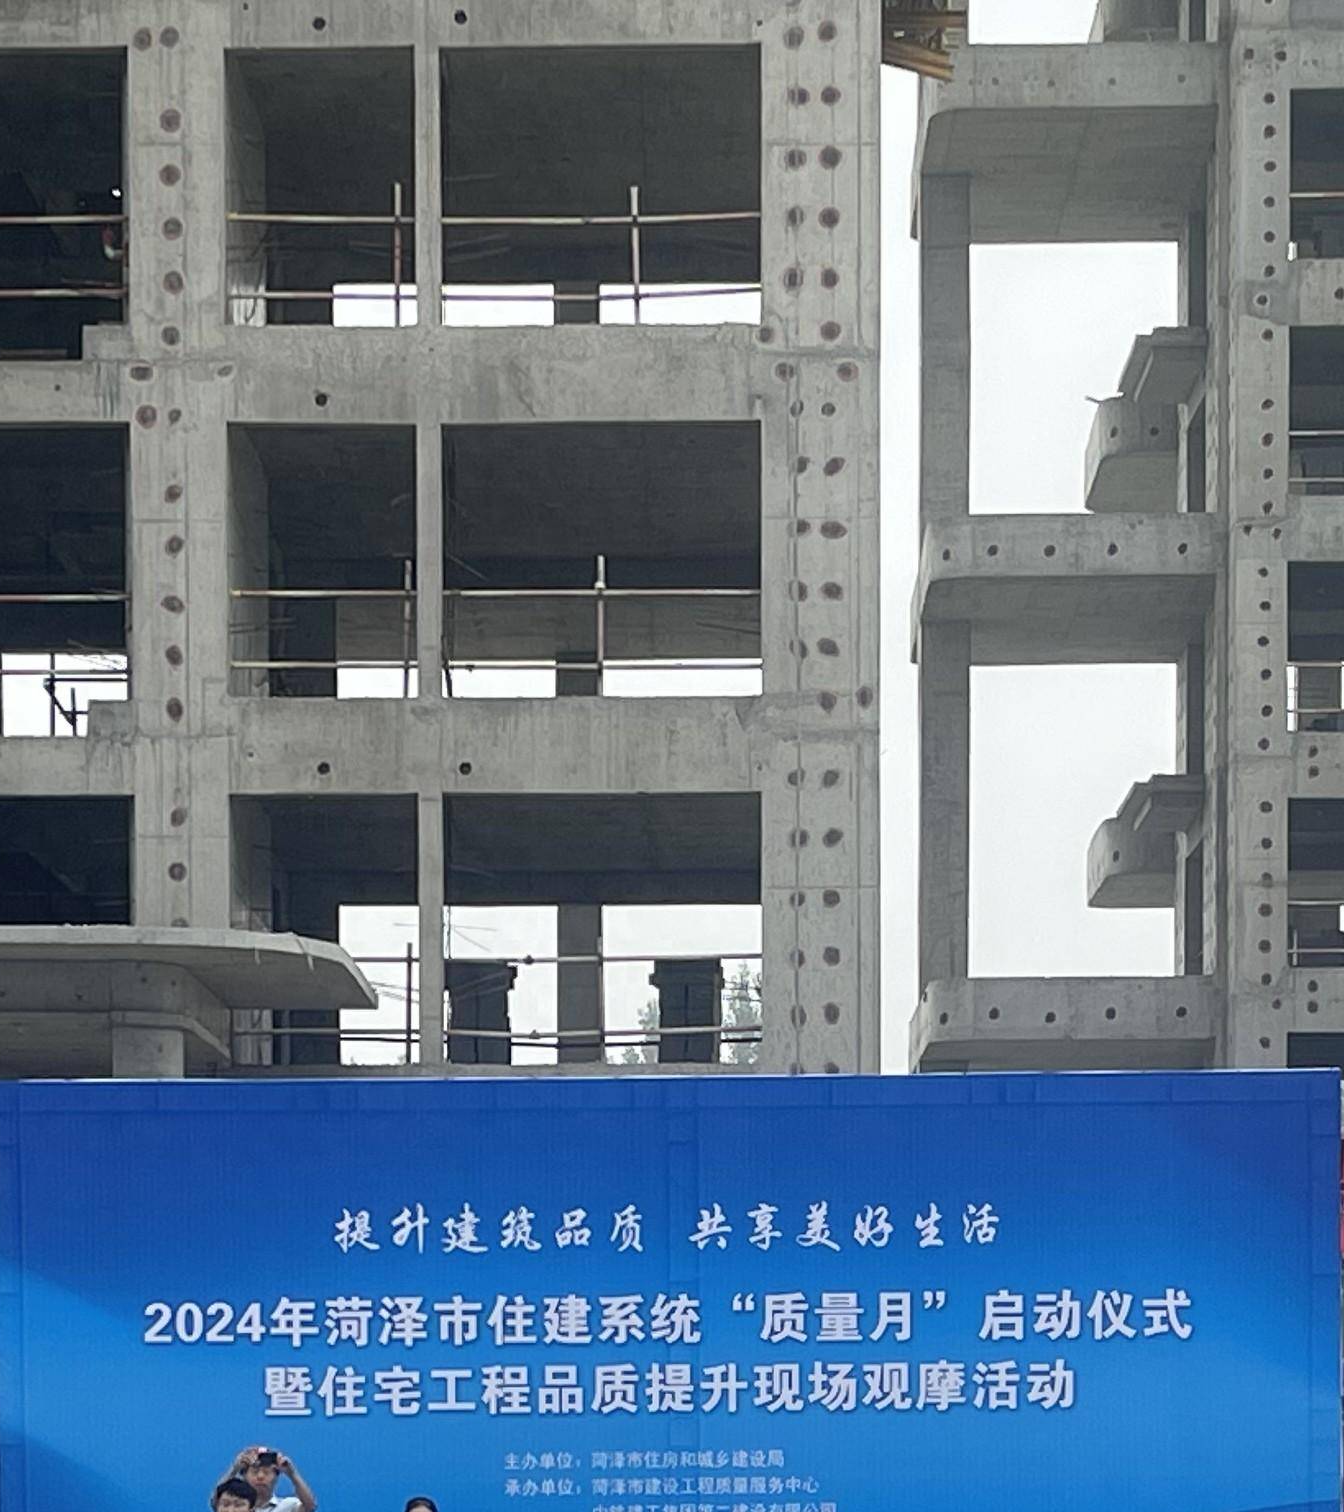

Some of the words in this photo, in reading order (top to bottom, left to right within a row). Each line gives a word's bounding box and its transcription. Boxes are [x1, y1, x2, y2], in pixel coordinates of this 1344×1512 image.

[334, 1201, 646, 1255] 提升建筑品质
[688, 1201, 1002, 1252] 共享美好生活
[264, 1360, 1076, 1418] 暨住宅工程品质提升现场观摩活动
